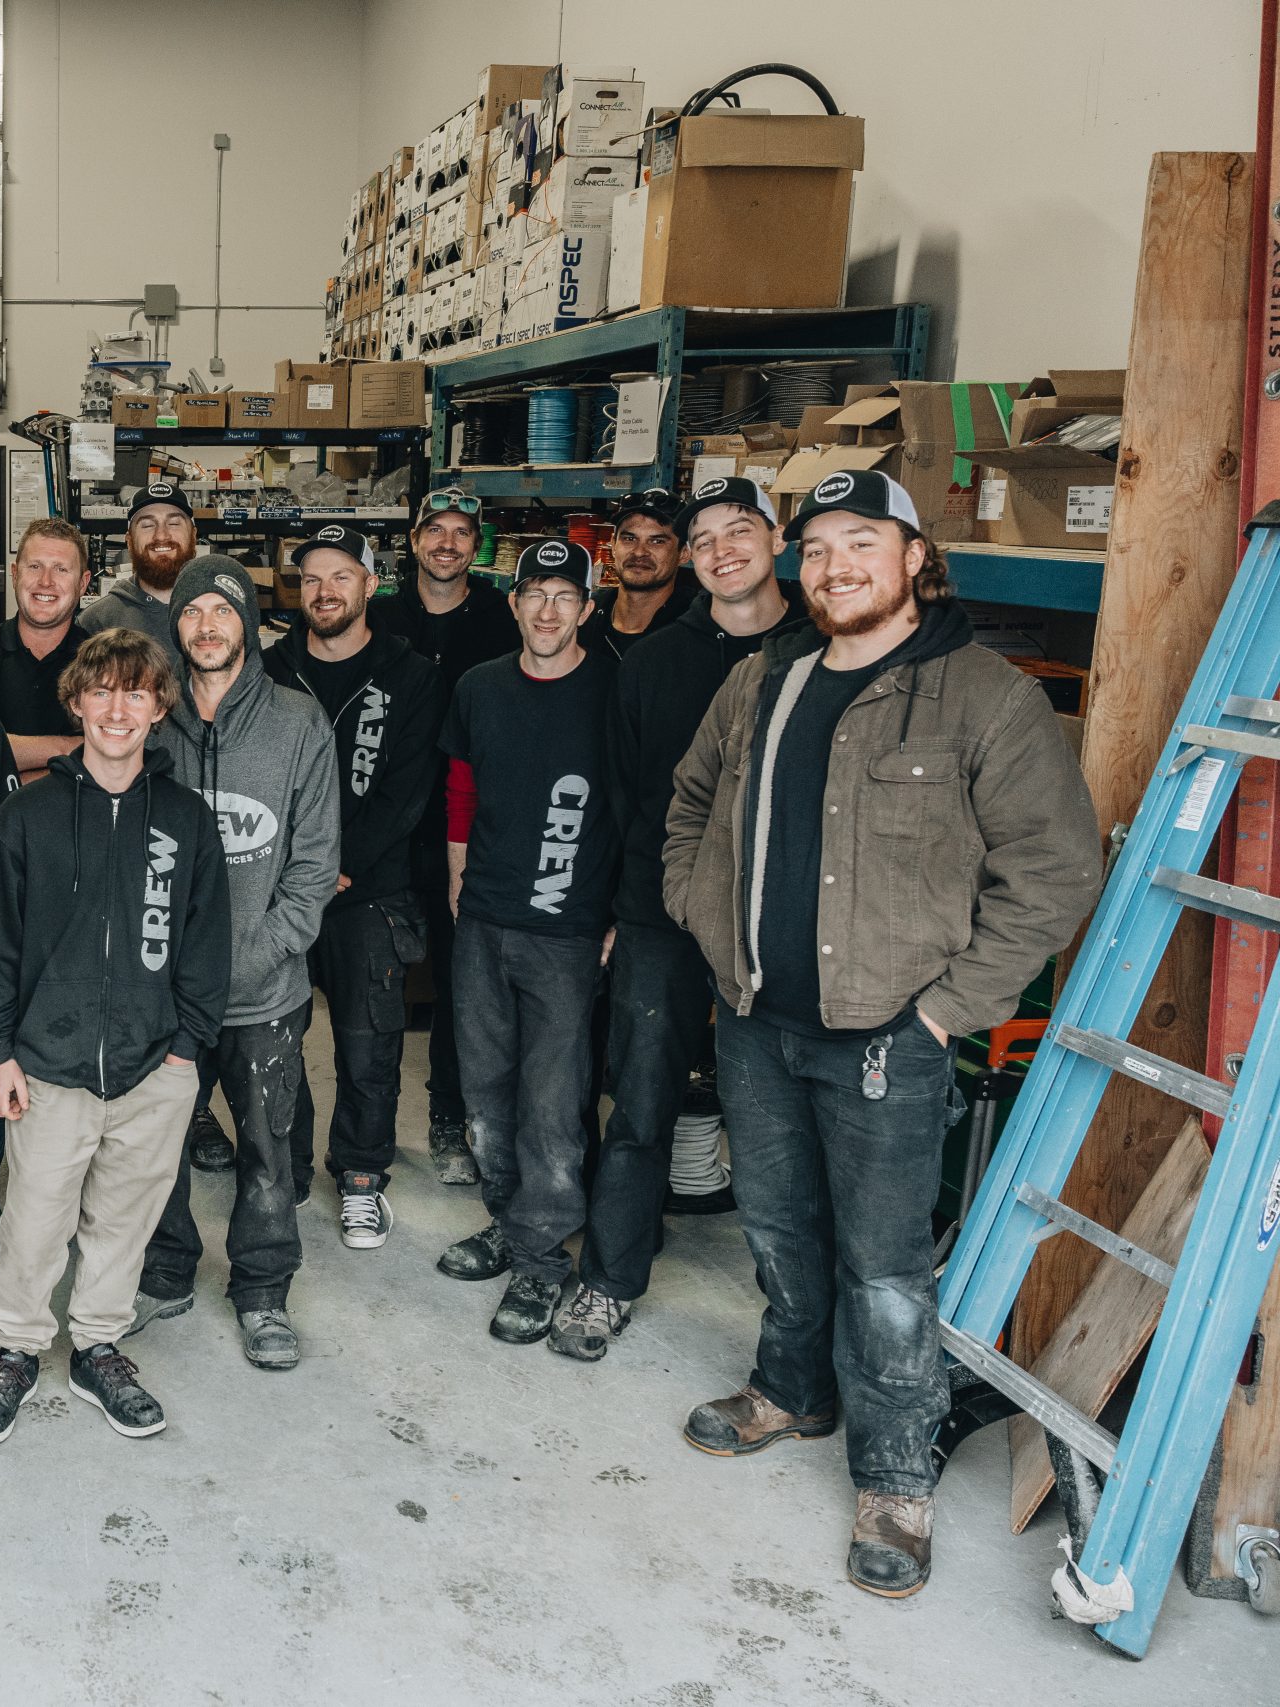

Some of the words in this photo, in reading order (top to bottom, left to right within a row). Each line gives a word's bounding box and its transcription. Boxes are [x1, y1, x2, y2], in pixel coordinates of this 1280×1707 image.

[151, 486, 170, 494] CREW
[699, 482, 724, 495] CREW
[820, 481, 849, 494] CREW
[320, 530, 342, 538] CREW
[541, 550, 565, 558] CREW
[351, 684, 391, 796] CREW
[218, 811, 263, 837] EW
[529, 774, 590, 915] CREW
[140, 826, 178, 972] CREW
